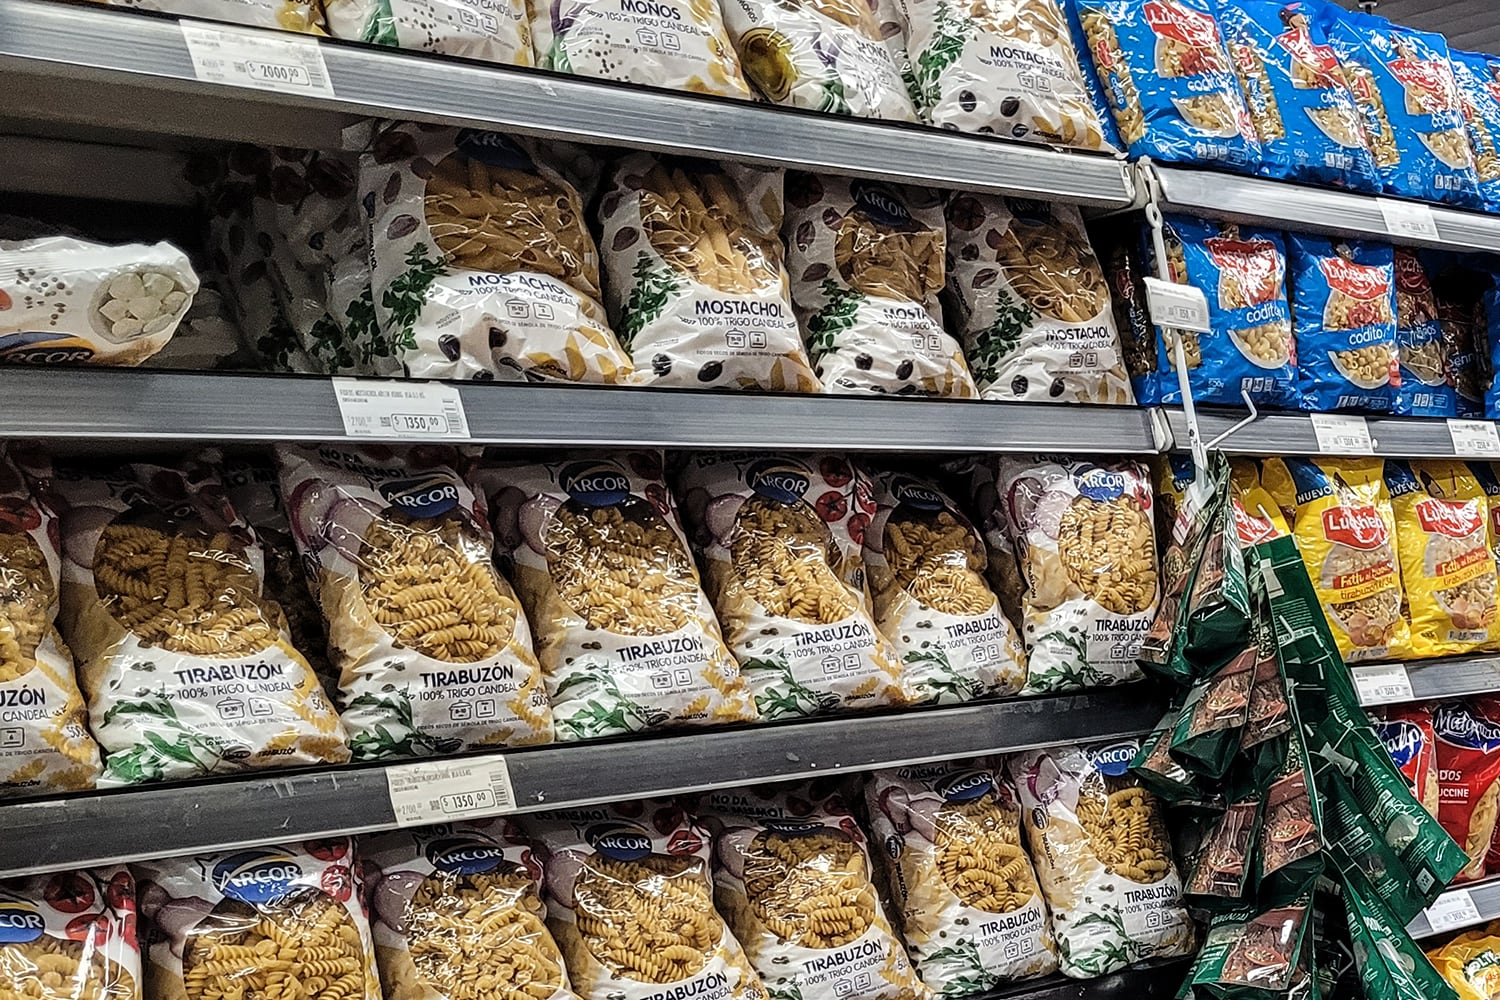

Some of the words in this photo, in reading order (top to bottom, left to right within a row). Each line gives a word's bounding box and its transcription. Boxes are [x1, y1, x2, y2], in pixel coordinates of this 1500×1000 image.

[660, 20, 700, 37] CANDEAL
[990, 45, 1063, 69] MOSTAC
[695, 301, 784, 319] MOSTACHOL
[884, 307, 926, 321] MOSTA
[1247, 307, 1286, 324] codit
[724, 318, 750, 328] TRIGO
[751, 319, 786, 329] CANDEAL
[1045, 327, 1110, 343] MOSTACHOL
[1349, 329, 1386, 346] codito
[403, 416, 439, 432] 1350,00
[565, 475, 628, 493] ARCOR
[753, 473, 807, 496] ARCOR
[1077, 472, 1124, 490] ARCOR
[388, 485, 458, 509] ARCOR
[896, 485, 942, 503] ARCOR
[1095, 615, 1153, 633] TIRABUZÓN
[791, 622, 870, 648] TIRABUZÓN
[616, 635, 705, 662] TIRABUZÓN
[173, 659, 284, 686] TIRABUZÓN
[419, 663, 514, 689] TIRABUZÓN
[176, 686, 208, 700] 100%
[210, 683, 245, 696] TRIGO
[417, 688, 445, 701] 100%
[446, 686, 477, 699] TRIGO
[478, 681, 517, 696] CANDEAL
[2, 709, 51, 722] CANDEAL
[1094, 750, 1137, 765] ARCOR
[942, 774, 991, 798] ARCOR
[452, 791, 487, 808] 1350,00
[591, 836, 651, 851] ARCOR
[432, 848, 502, 867] ARCOR
[223, 865, 300, 889] ARCOR
[1124, 885, 1178, 904] TIRABUZÓN
[0, 913, 41, 930] COR
[979, 907, 1041, 936] TIRABUZÓN
[803, 938, 883, 974] TIRABUZÓN
